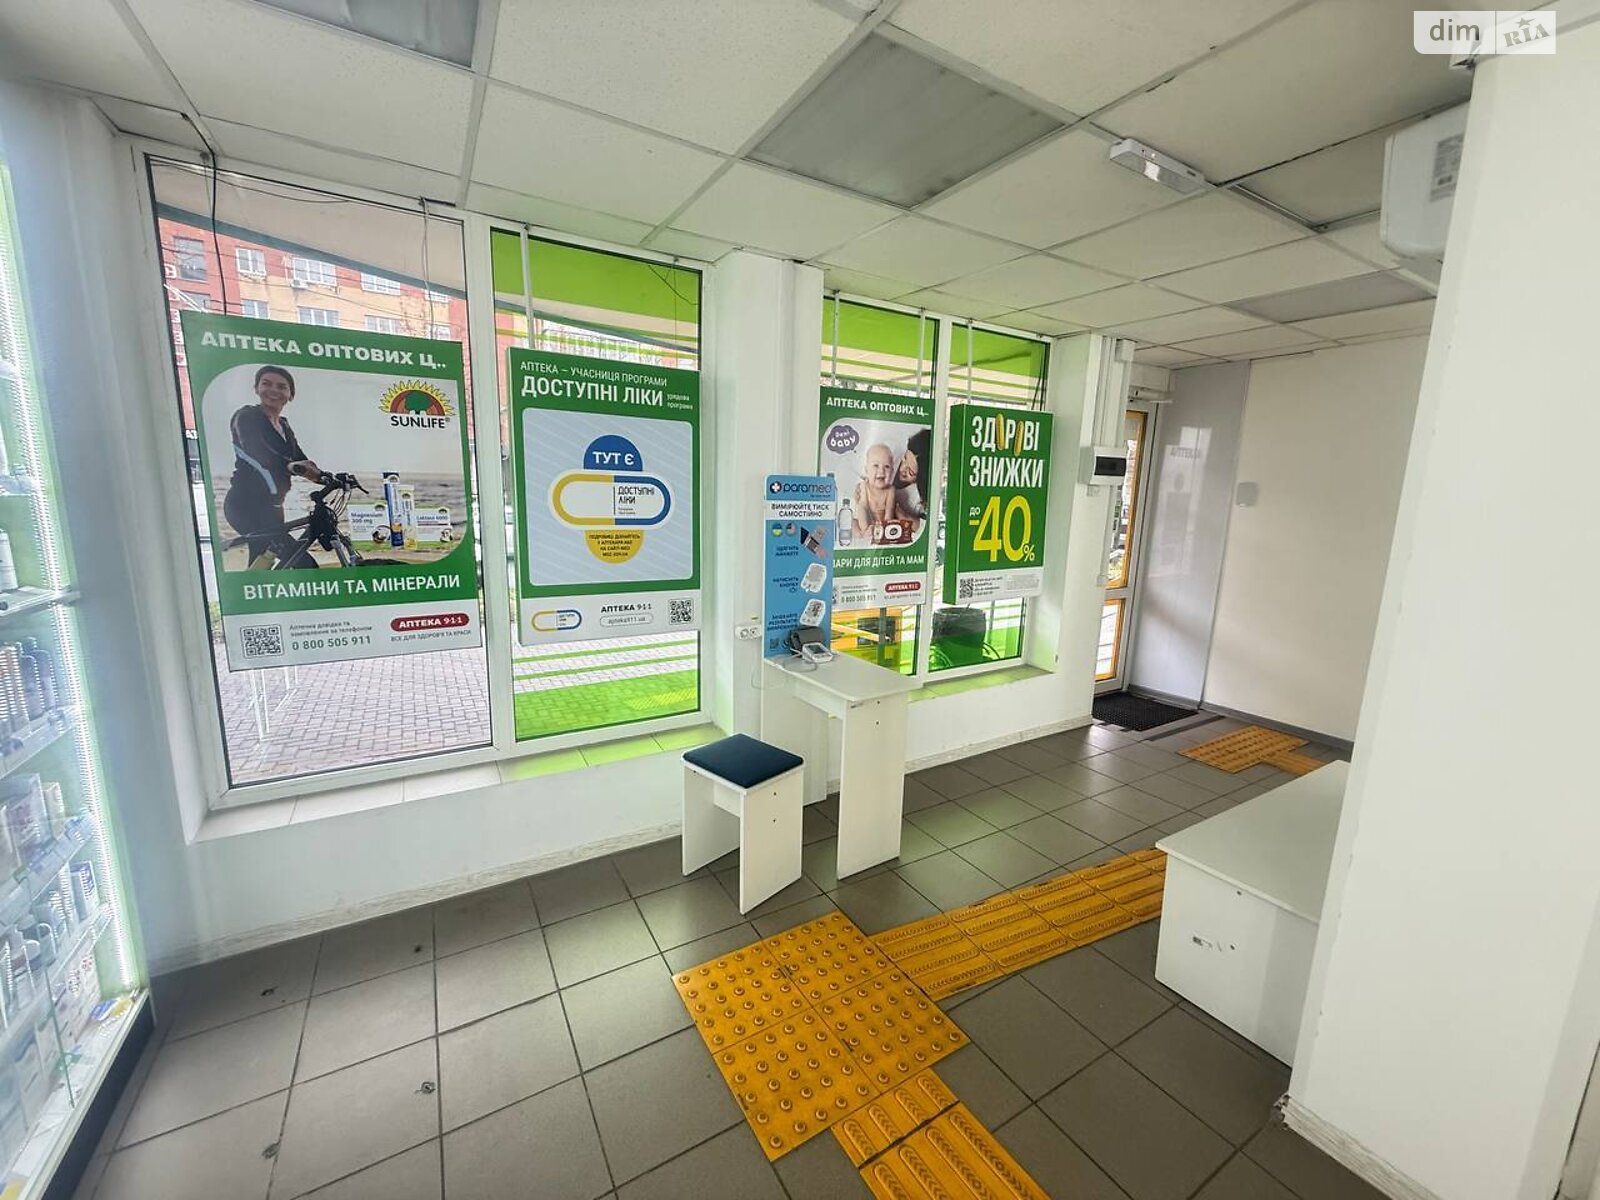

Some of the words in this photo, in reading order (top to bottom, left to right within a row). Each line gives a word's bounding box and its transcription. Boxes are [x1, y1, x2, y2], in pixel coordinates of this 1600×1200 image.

[200, 331, 301, 354] АПТЕКА
[308, 342, 414, 366] ОПТОВИХ
[520, 361, 559, 374] АПТЕКА
[571, 367, 620, 382] УЧАСНИЦЯ
[622, 373, 667, 386] ПРОГРАМИ
[521, 376, 617, 402] ДОСТУПНІ
[623, 387, 663, 407] ЛІКИ
[826, 397, 867, 410] АПТЕКА
[870, 401, 914, 414] ОПТОВИХ
[390, 415, 445, 429] SUNLIFE
[830, 436, 856, 447] baby
[592, 451, 621, 464] ТУТ
[624, 454, 634, 465] Є
[969, 455, 1045, 488] ЗНИЖКИ
[618, 486, 655, 495] ДОСТУПНІ
[783, 484, 831, 493] paramed
[618, 496, 636, 504] ЛІКИ
[854, 558, 871, 569] ДЛЯ
[872, 555, 894, 568] ДІТЕЙ
[896, 556, 905, 565] ТА
[906, 555, 924, 564] МАМ
[244, 580, 339, 600] ВІТАМІНИ
[344, 579, 367, 594] ТА
[372, 574, 460, 592] МІНЕРАЛИ
[601, 604, 636, 613] АПТЕКА
[399, 618, 441, 628] АПТЕКА
[292, 641, 299, 650] 0
[303, 640, 324, 650] 800
[328, 637, 348, 648] 505
[352, 635, 370, 645] 911
